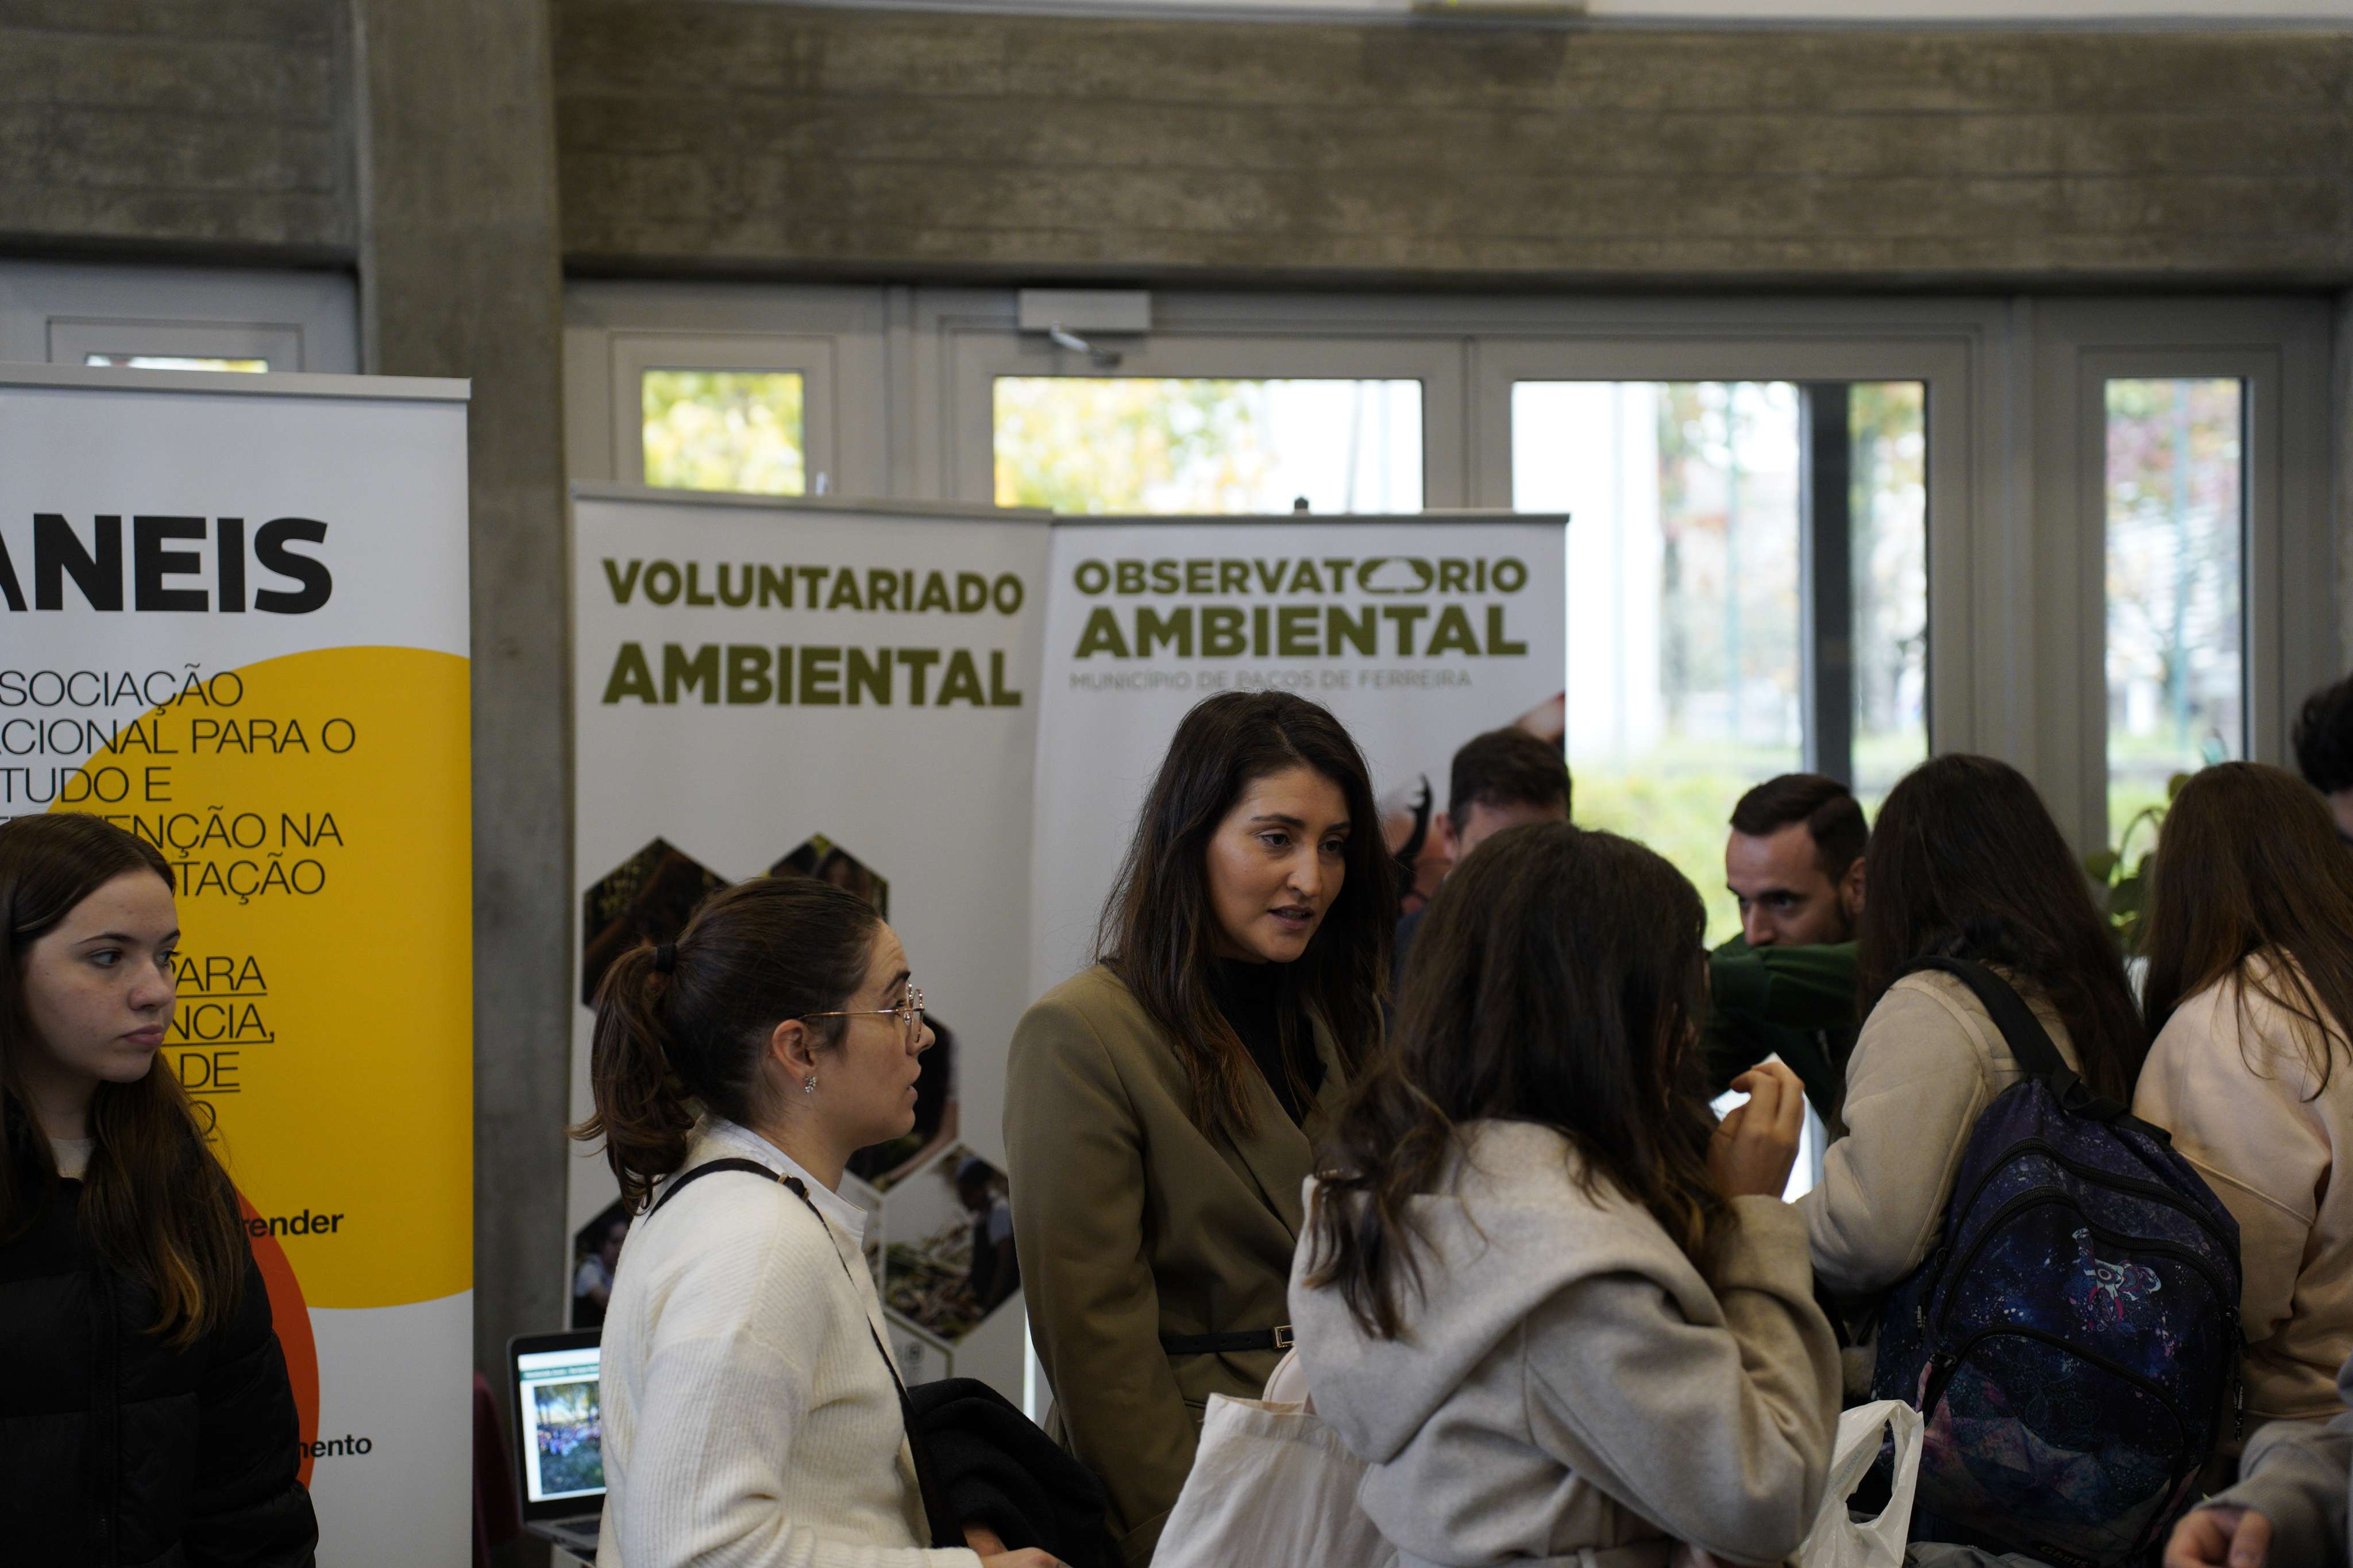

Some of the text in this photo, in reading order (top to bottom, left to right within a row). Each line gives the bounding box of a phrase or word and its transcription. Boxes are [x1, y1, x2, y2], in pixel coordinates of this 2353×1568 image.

[602, 558, 1024, 616] VOLUNTARIADO
[1073, 604, 1529, 659] AMBIENTAL
[601, 642, 1023, 708] AMBIENTAL
[1321, 670, 1352, 689] DE
[1359, 669, 1474, 688] FERREIRA
[0, 718, 356, 755] CIONAL PARA O
[0, 767, 172, 804] TUDO E
[105, 806, 344, 858] NÇÃO NA
[171, 955, 267, 992] ARA
[180, 1052, 240, 1089] DE
